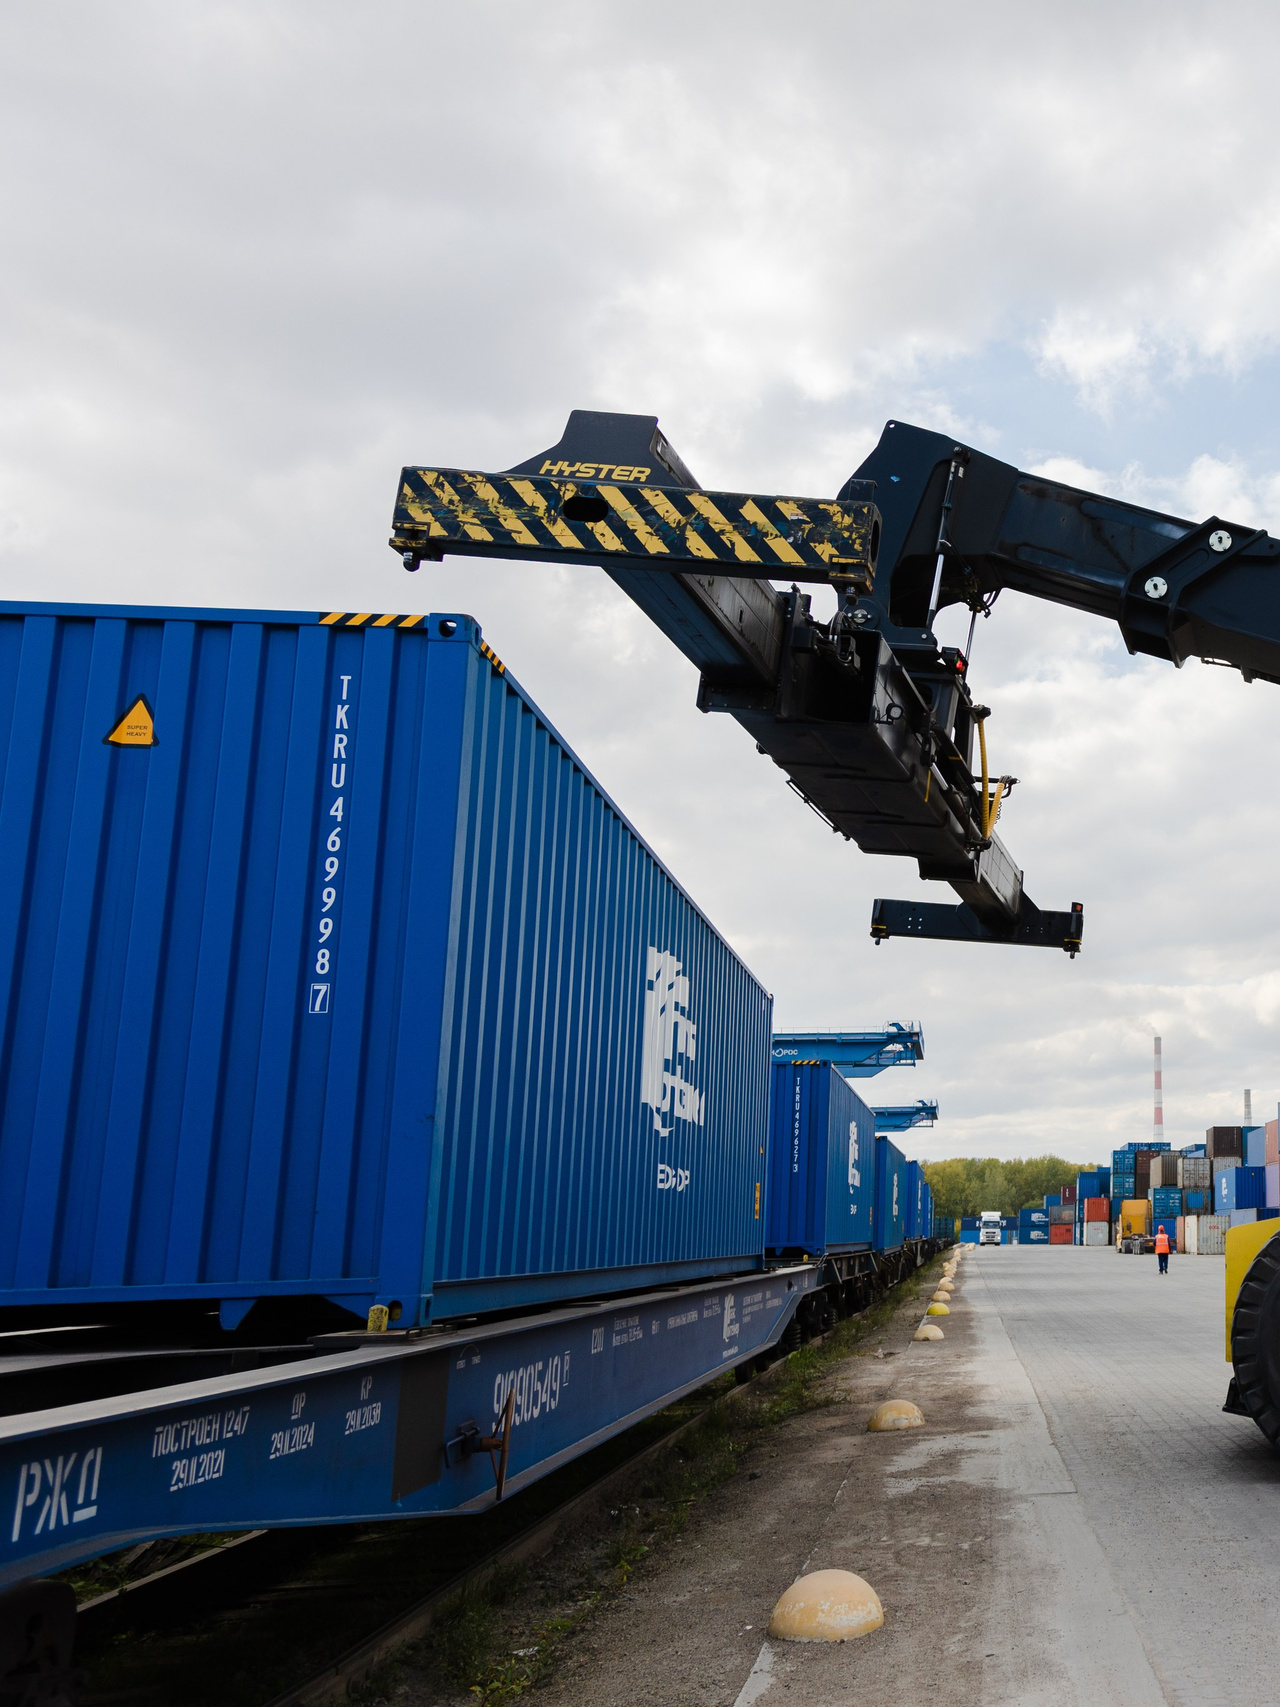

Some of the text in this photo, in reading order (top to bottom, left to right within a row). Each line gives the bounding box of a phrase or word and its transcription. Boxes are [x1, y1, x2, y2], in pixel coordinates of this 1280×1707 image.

[539, 459, 652, 483] HYSTER
[330, 675, 353, 789] TKRU
[314, 797, 344, 975] 469998
[152, 1405, 251, 1458] ПОСТРОЕН 1247
[11, 1446, 104, 1543] РЖД
[169, 1448, 226, 1492] 29.11.2021
